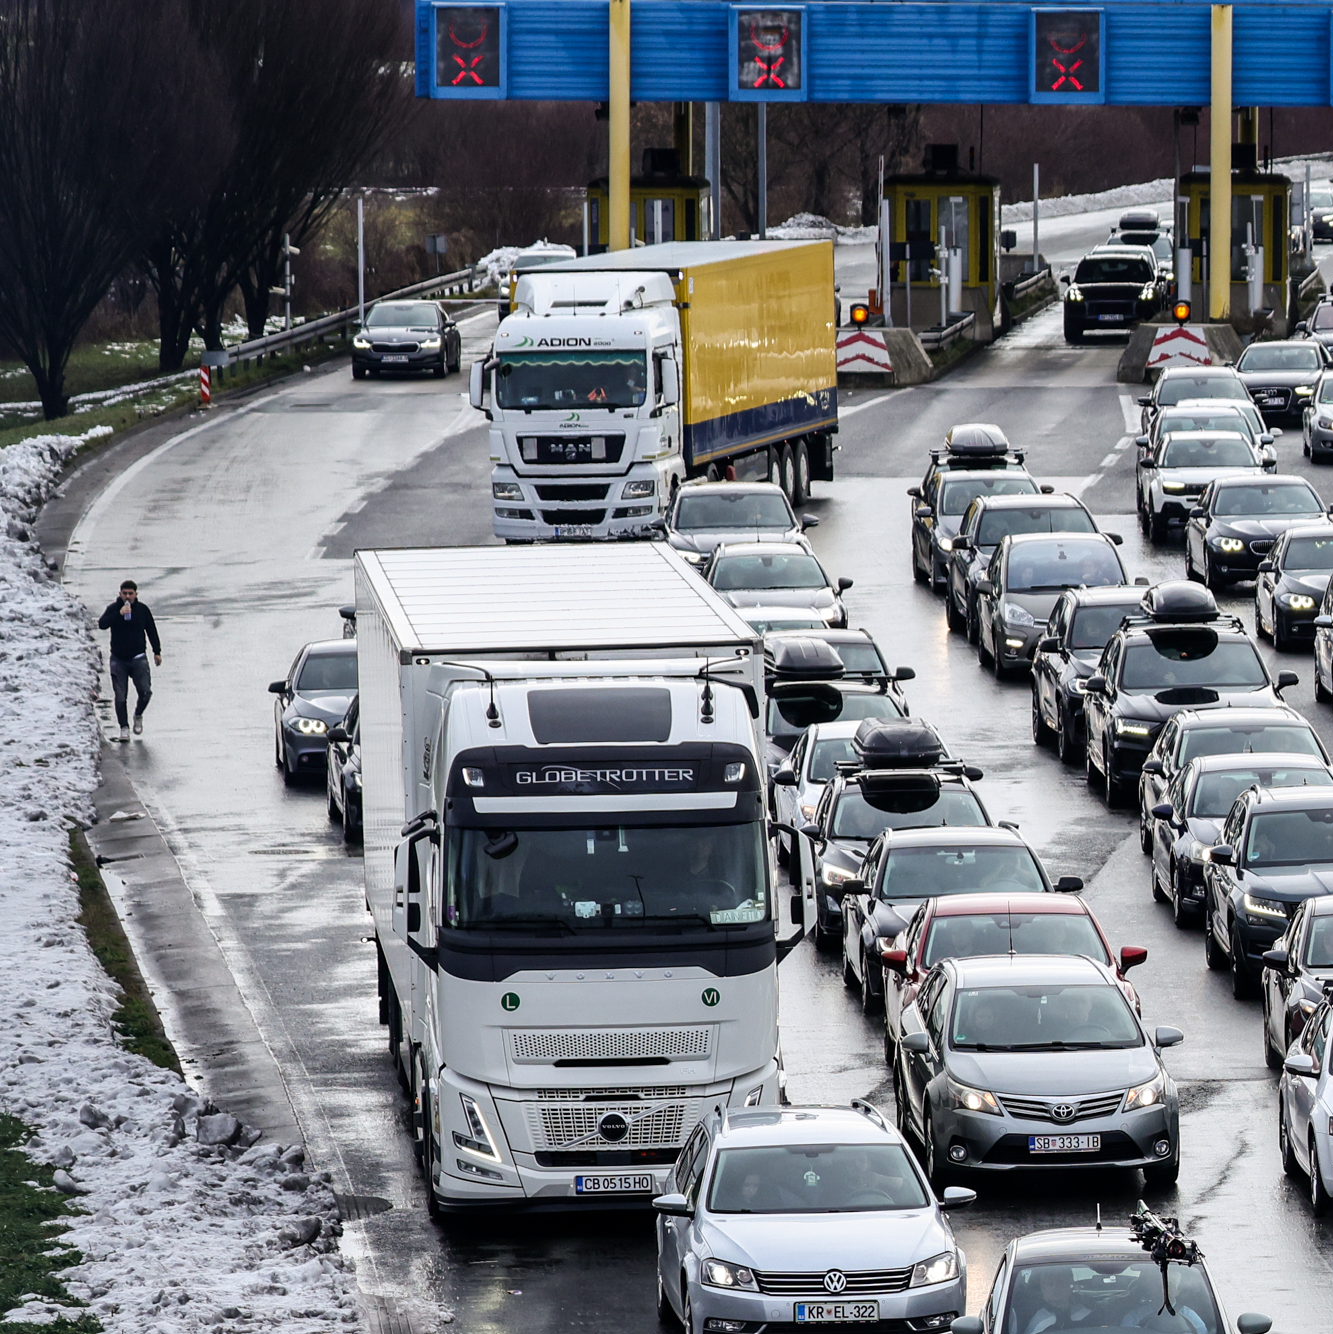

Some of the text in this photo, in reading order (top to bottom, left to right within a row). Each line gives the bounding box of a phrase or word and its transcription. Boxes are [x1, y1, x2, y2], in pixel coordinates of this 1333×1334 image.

[537, 337, 594, 347] ADION
[550, 443, 591, 452] MAN
[516, 768, 695, 785] GLOBETROTTER
[546, 972, 672, 980] VOLVO
[507, 995, 516, 1008] L
[705, 992, 718, 1004] VI
[1036, 1136, 1051, 1149] SB
[1058, 1135, 1100, 1148] 333-IB
[585, 1178, 601, 1190] CB
[603, 1177, 632, 1189] 0515
[807, 1305, 824, 1319] KR
[834, 1303, 876, 1319] EL-322
